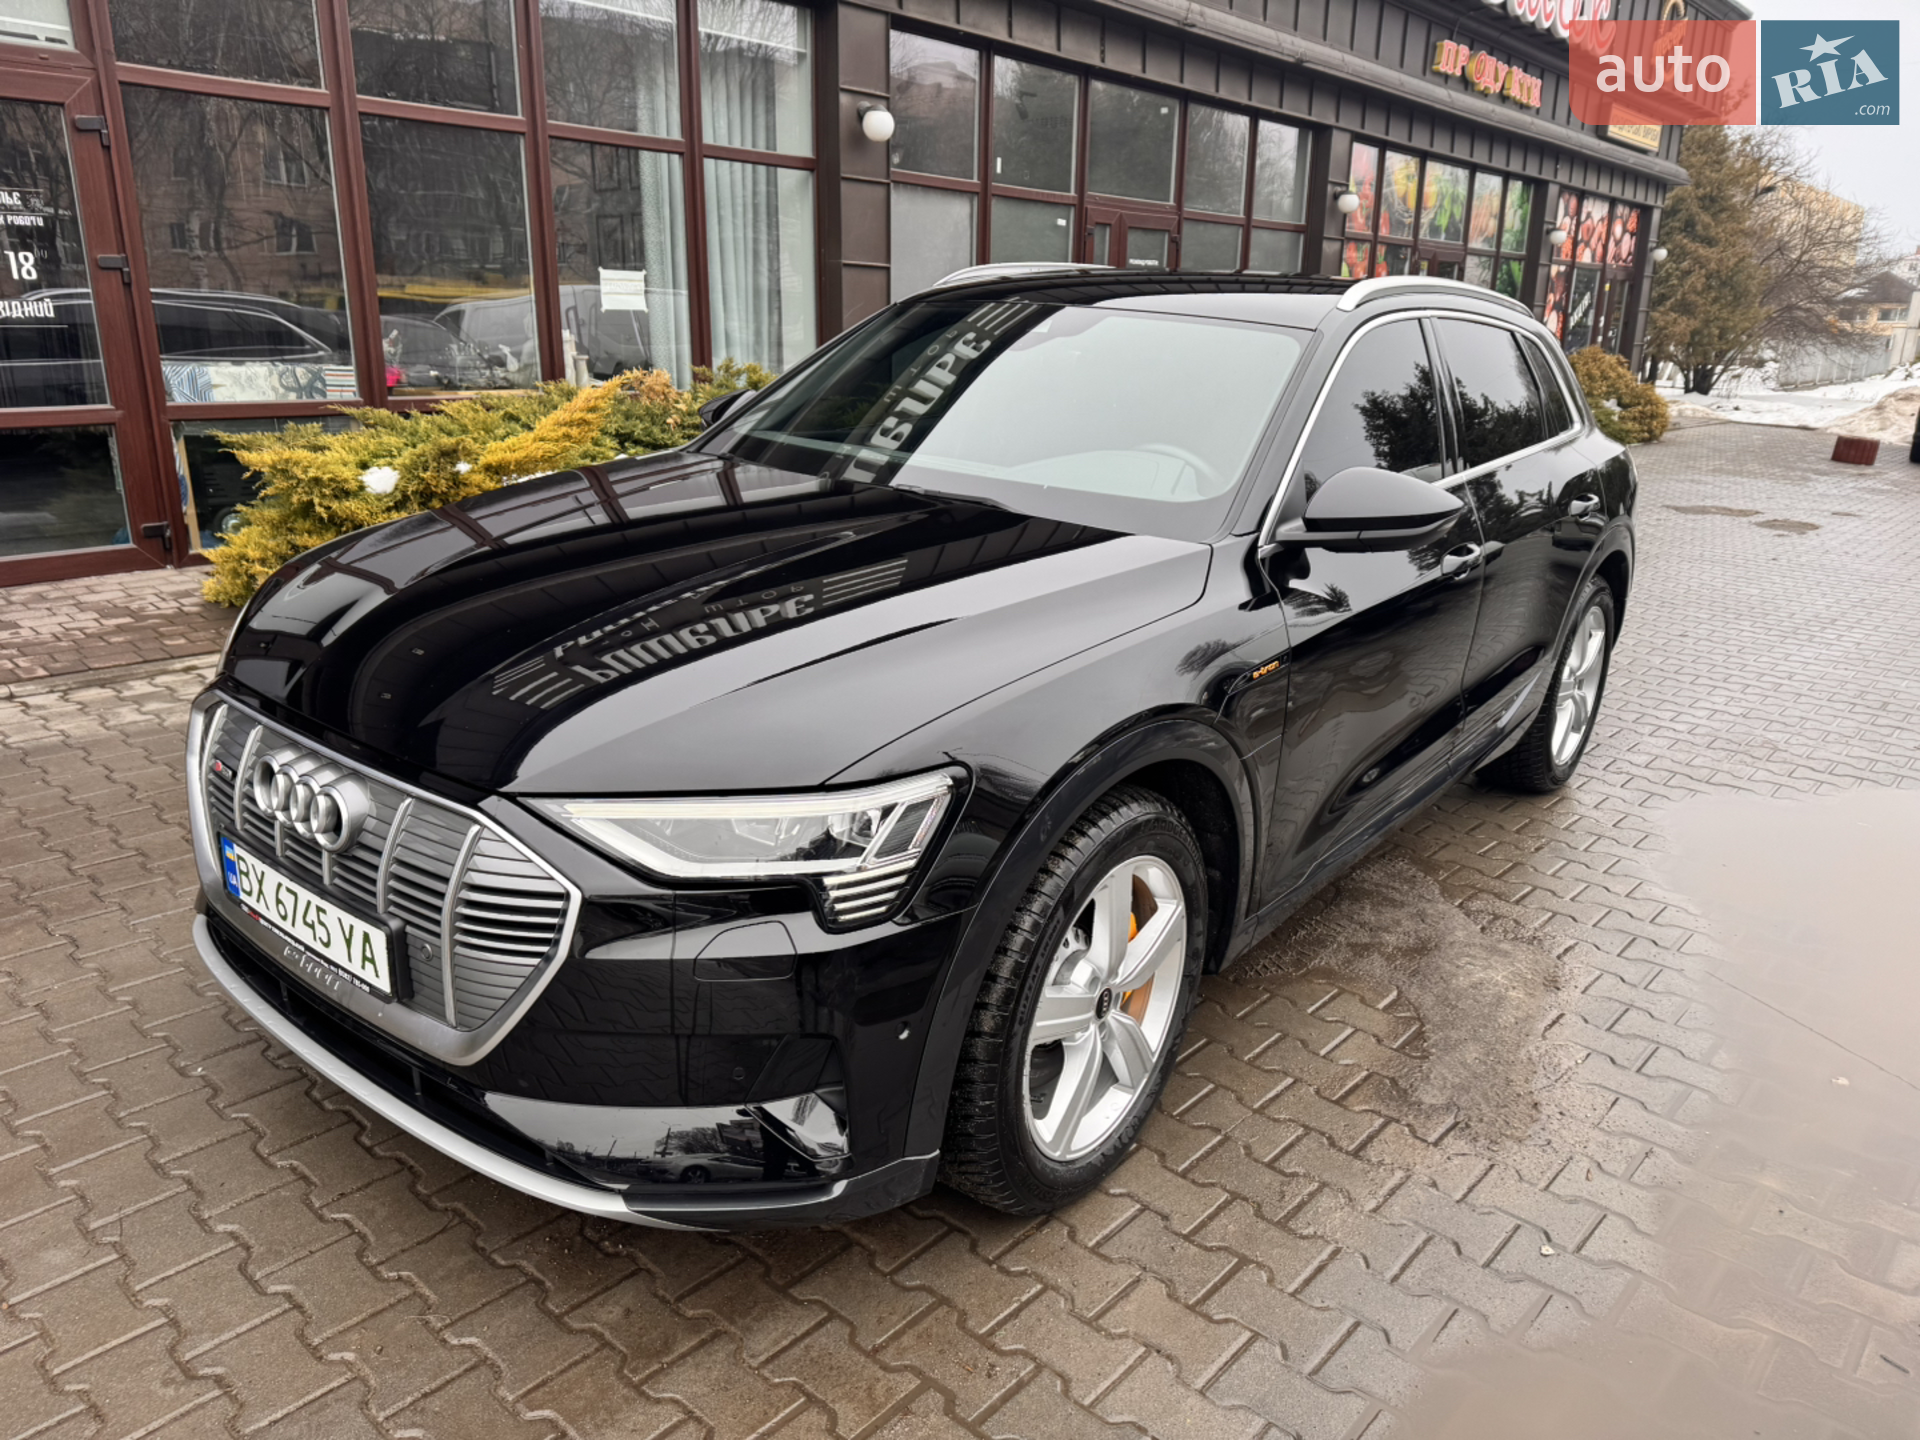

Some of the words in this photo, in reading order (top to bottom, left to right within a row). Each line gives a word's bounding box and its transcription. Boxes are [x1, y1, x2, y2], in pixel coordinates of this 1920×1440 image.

[4, 250, 38, 281] 18
[236, 852, 270, 912] BX
[275, 881, 332, 949] 6745
[337, 916, 380, 979] YA
